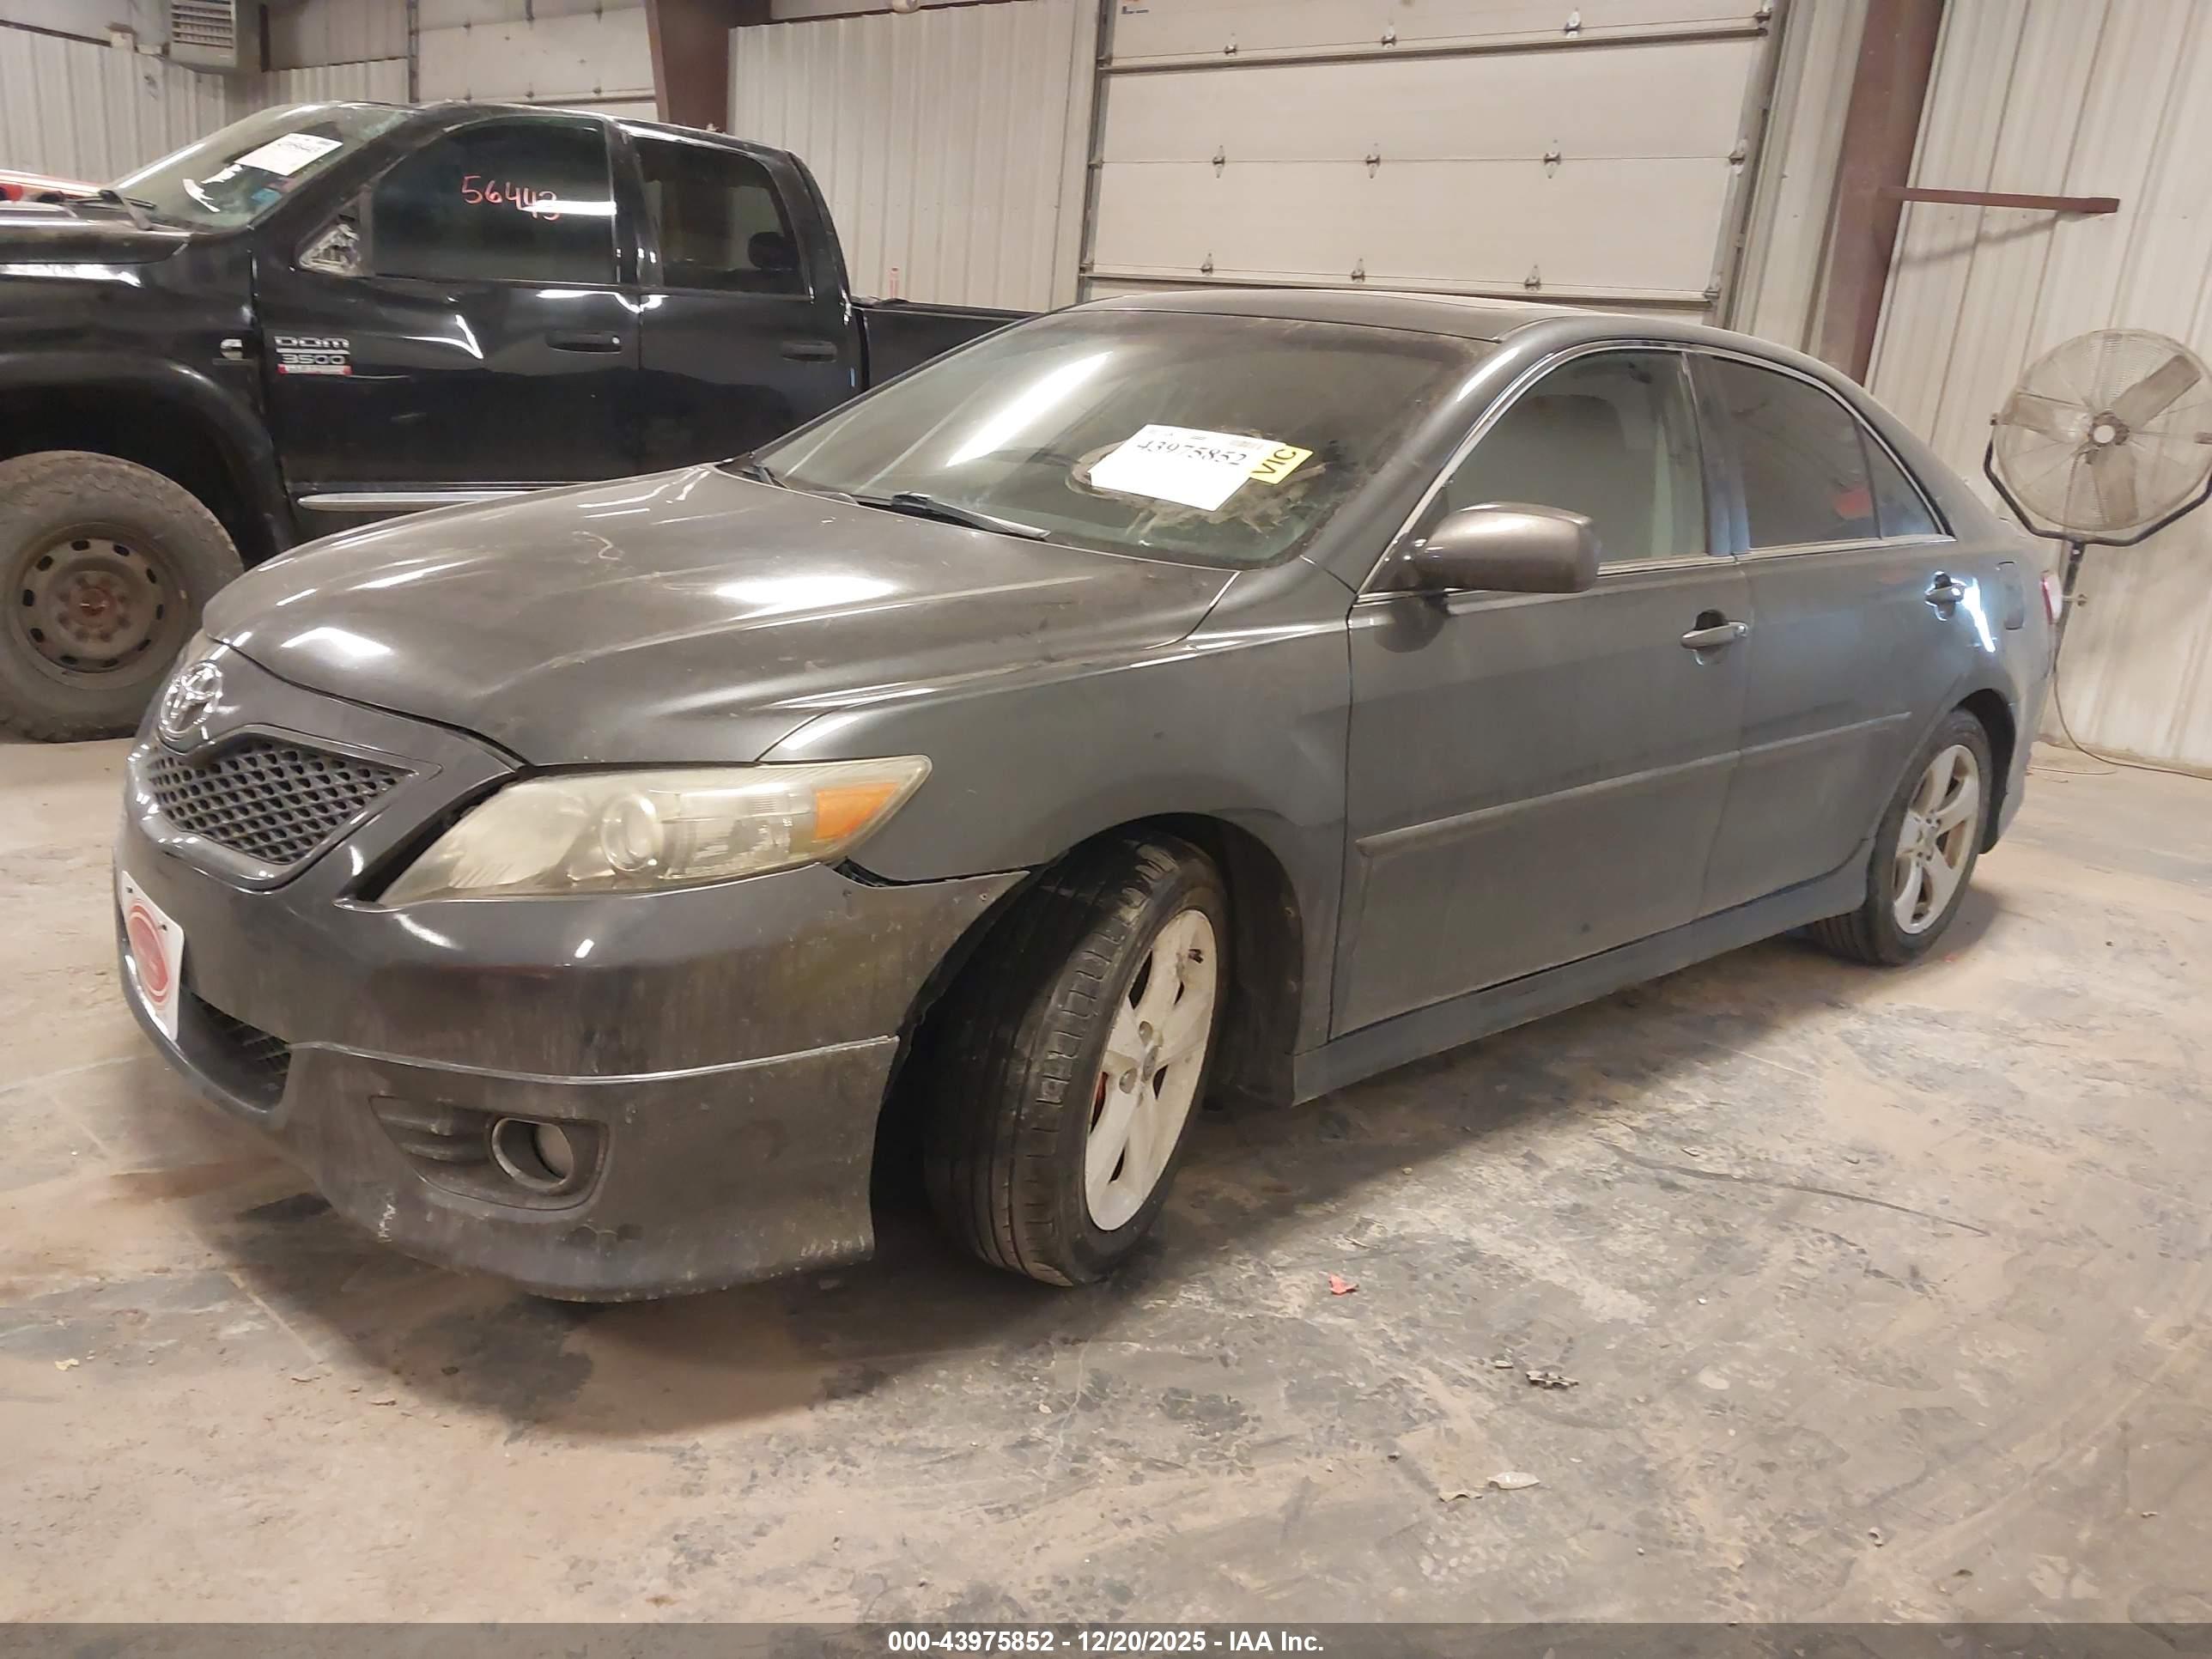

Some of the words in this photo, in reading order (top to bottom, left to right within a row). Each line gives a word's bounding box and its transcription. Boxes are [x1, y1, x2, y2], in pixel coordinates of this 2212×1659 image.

[461, 173, 562, 222] 56443
[282, 353, 346, 365] 3500
[1136, 440, 1248, 466] 43975852
[1250, 448, 1297, 474] VIC
